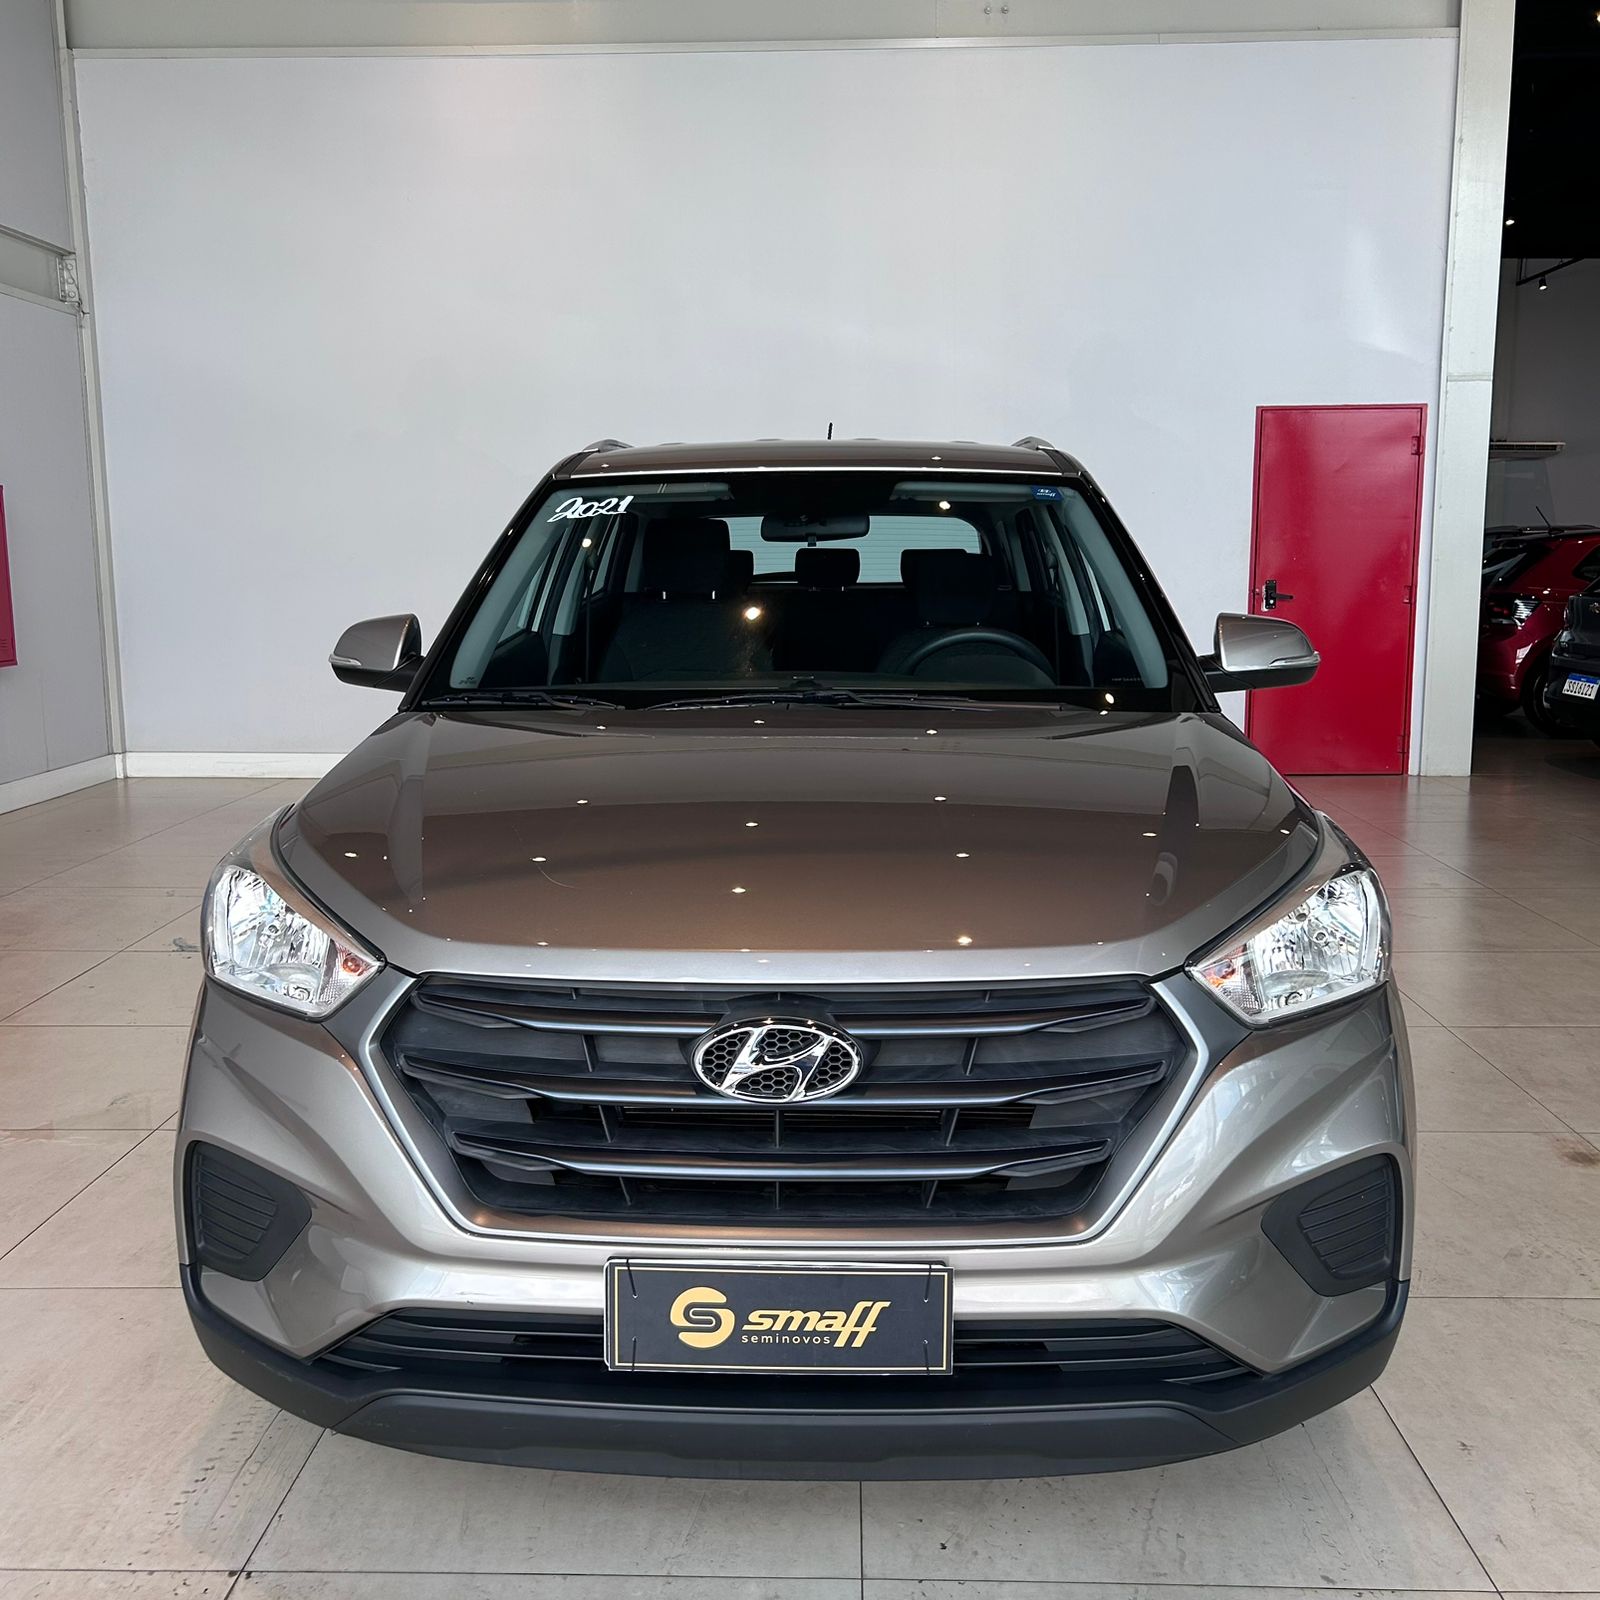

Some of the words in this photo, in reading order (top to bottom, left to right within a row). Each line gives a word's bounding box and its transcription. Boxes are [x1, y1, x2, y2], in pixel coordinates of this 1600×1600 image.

[546, 495, 634, 522] 2021
[742, 1301, 891, 1348] smaff
[741, 1333, 831, 1345] seminovos
